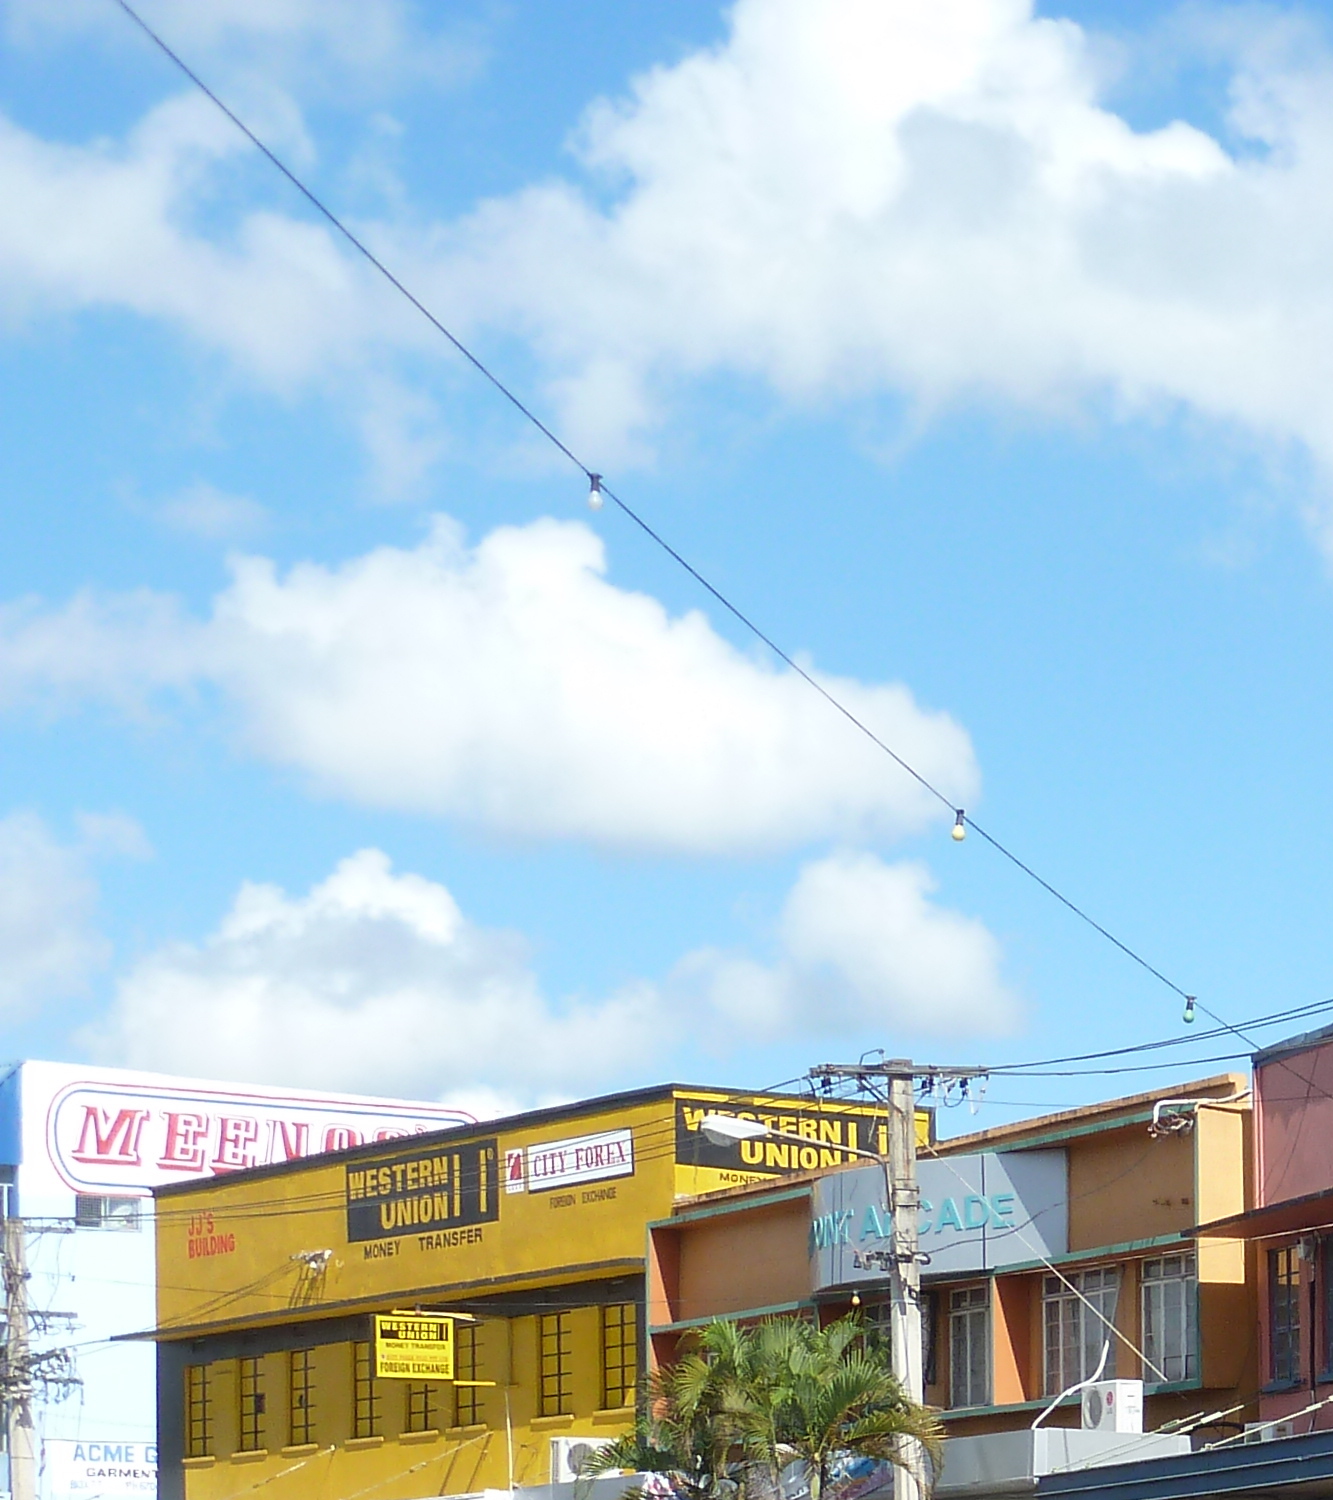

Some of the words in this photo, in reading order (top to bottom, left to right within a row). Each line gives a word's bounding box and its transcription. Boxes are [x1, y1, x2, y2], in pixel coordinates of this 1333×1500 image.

[534, 1150, 567, 1177] CITY
[575, 1141, 626, 1170] FOREX
[741, 1141, 842, 1169] UNION
[348, 1156, 448, 1200] WESTERN
[582, 1187, 617, 1204] EXCHANGE
[381, 1192, 448, 1230] UNION
[188, 1212, 214, 1236] JJ'S
[189, 1233, 236, 1259] BUILDING
[364, 1240, 401, 1260] MONEY
[418, 1228, 483, 1251] TRANSFER
[381, 1322, 437, 1331] WESTERN
[398, 1331, 437, 1339] UNION
[380, 1362, 410, 1373] FOREIGN
[412, 1363, 449, 1374] EXCHANGE
[73, 1444, 134, 1463] ACME
